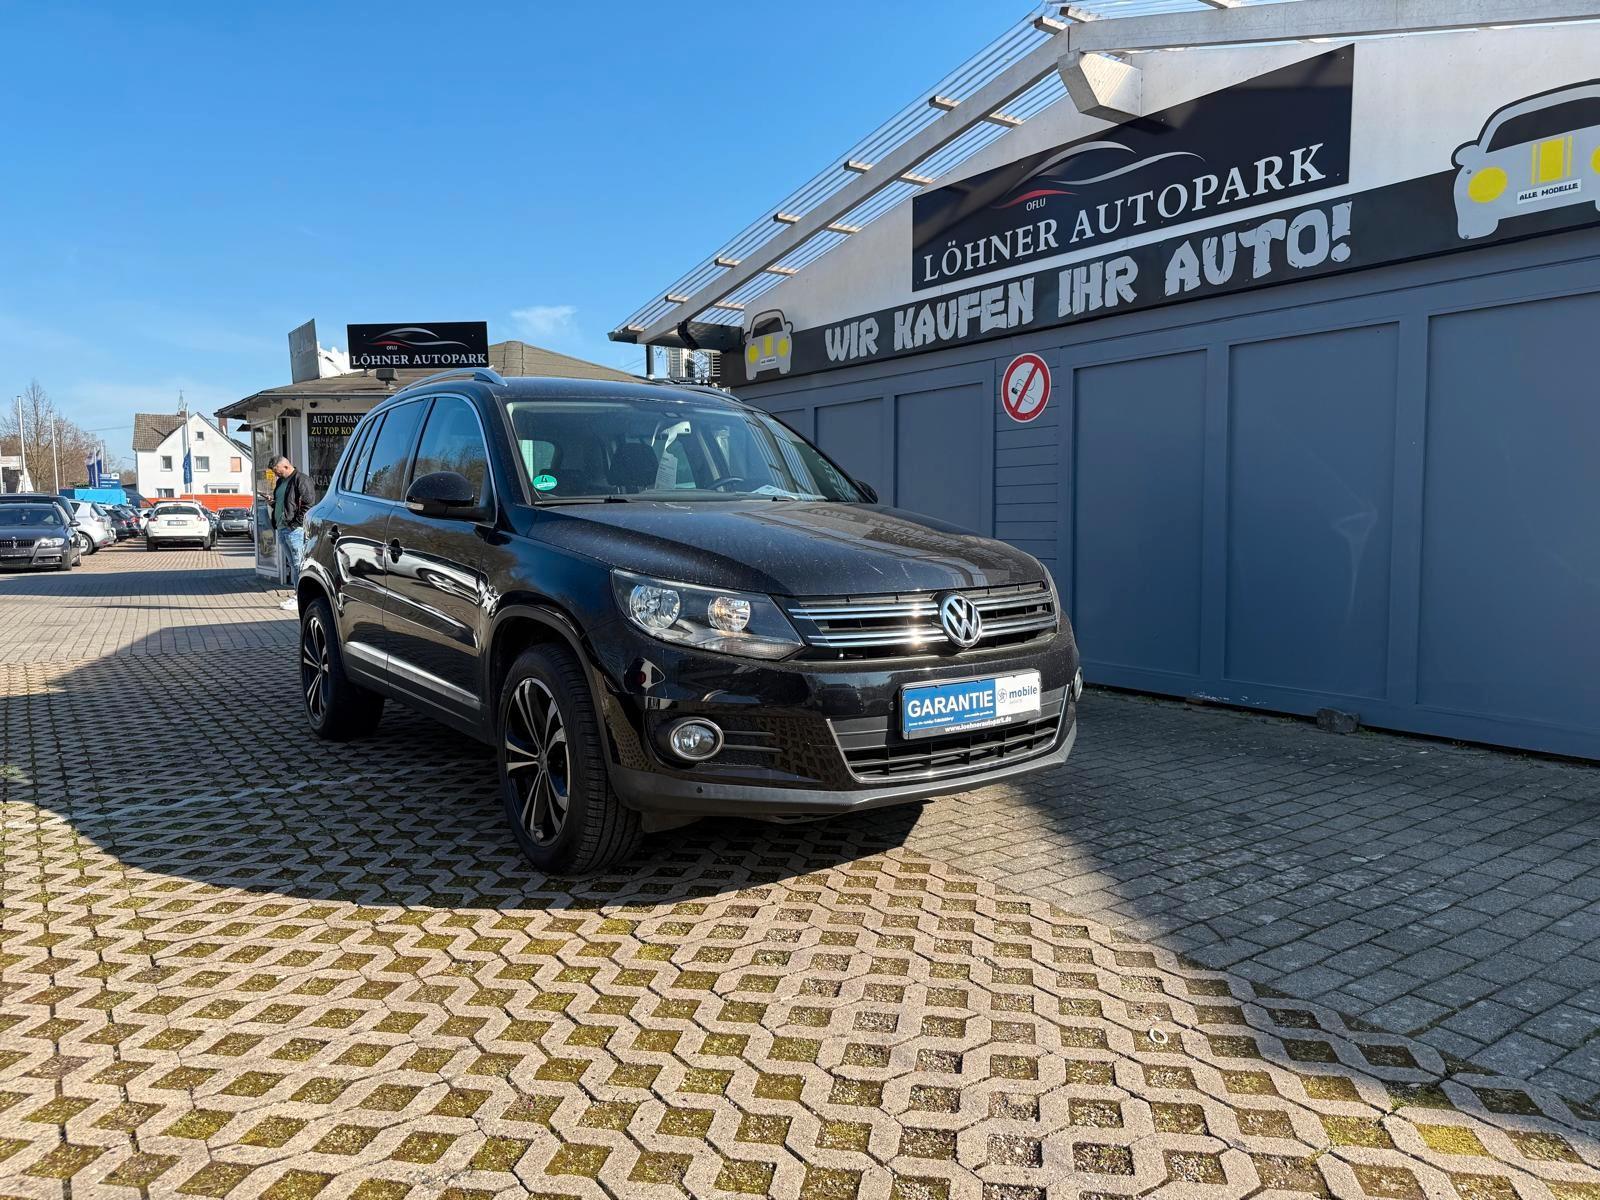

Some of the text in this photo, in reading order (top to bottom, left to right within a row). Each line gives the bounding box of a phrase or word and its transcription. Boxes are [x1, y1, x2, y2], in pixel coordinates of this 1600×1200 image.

[1519, 183, 1578, 200] ALLE MODELLE
[923, 142, 1327, 282] LÖHNER AUTOPARK
[1026, 197, 1047, 212] OFLU
[824, 200, 1353, 362] WIR KAUFEN IHR AUTO!
[352, 353, 487, 366] LÖHNER AUTOPARK
[312, 415, 334, 424] AUTO
[311, 426, 321, 435] ZU
[324, 426, 340, 435] TOP
[907, 690, 994, 718] GARANTIE
[1009, 685, 1038, 699] mobile
